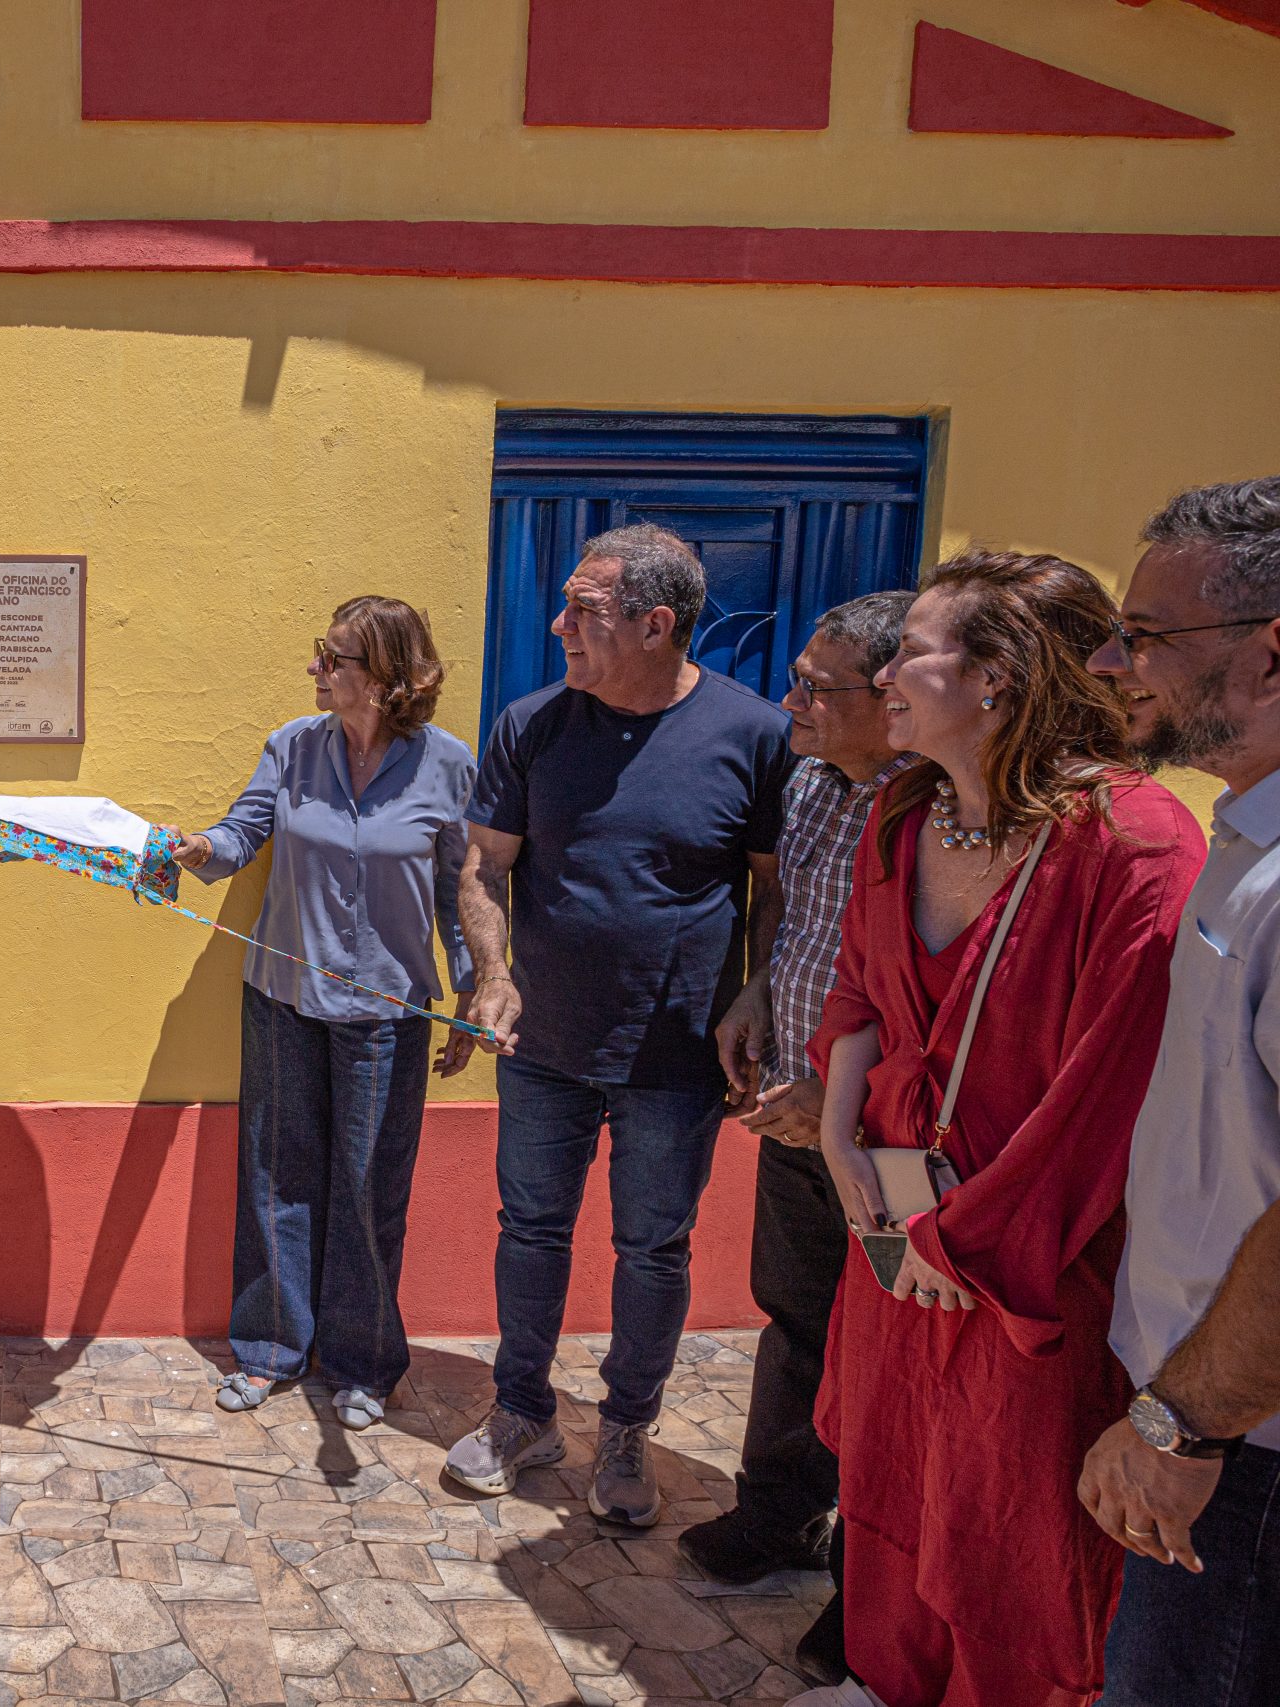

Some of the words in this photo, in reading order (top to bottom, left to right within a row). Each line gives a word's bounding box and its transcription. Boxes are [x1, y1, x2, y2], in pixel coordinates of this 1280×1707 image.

[2, 575, 48, 585] OFICINA
[51, 576, 67, 585] DO
[8, 586, 71, 596] FRANCISCO
